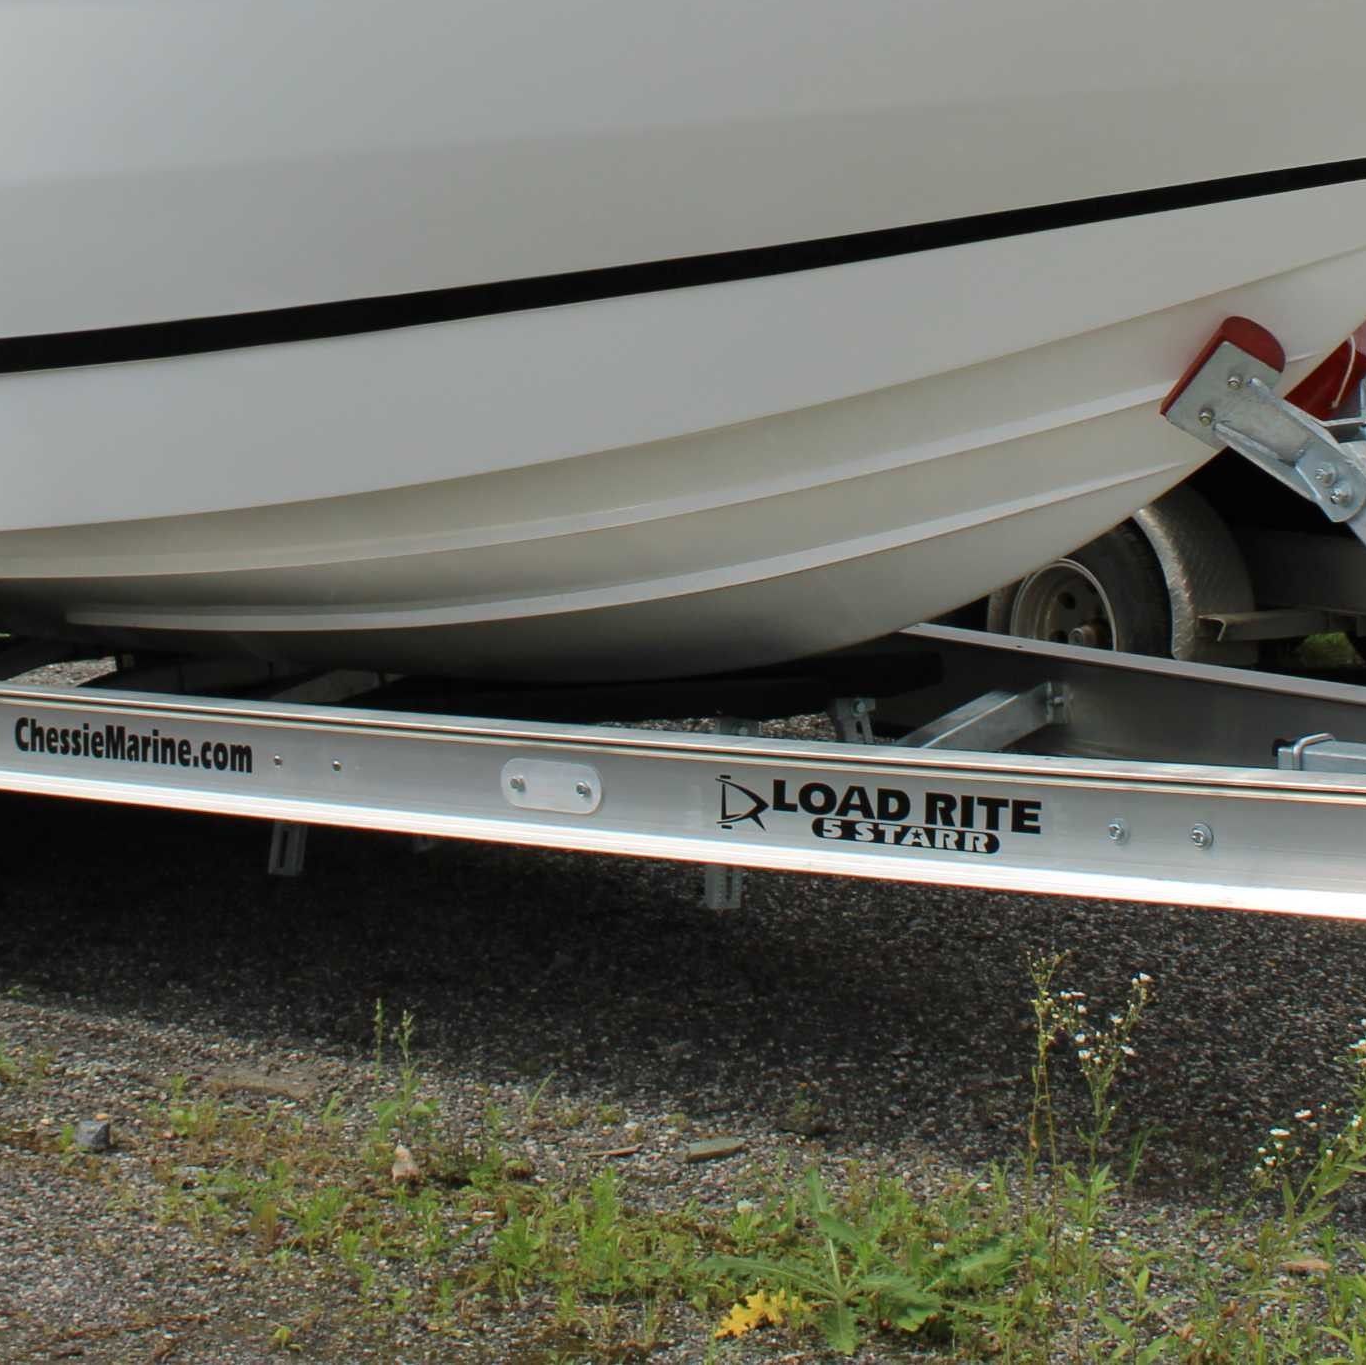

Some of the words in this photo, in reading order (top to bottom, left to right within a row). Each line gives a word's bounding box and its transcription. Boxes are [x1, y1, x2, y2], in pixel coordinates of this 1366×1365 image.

[14, 716, 253, 773] ChessieMarine.com
[772, 778, 911, 821] LOAD
[924, 791, 1042, 835] RITE
[822, 818, 842, 839] 5
[854, 823, 990, 853] STARR
